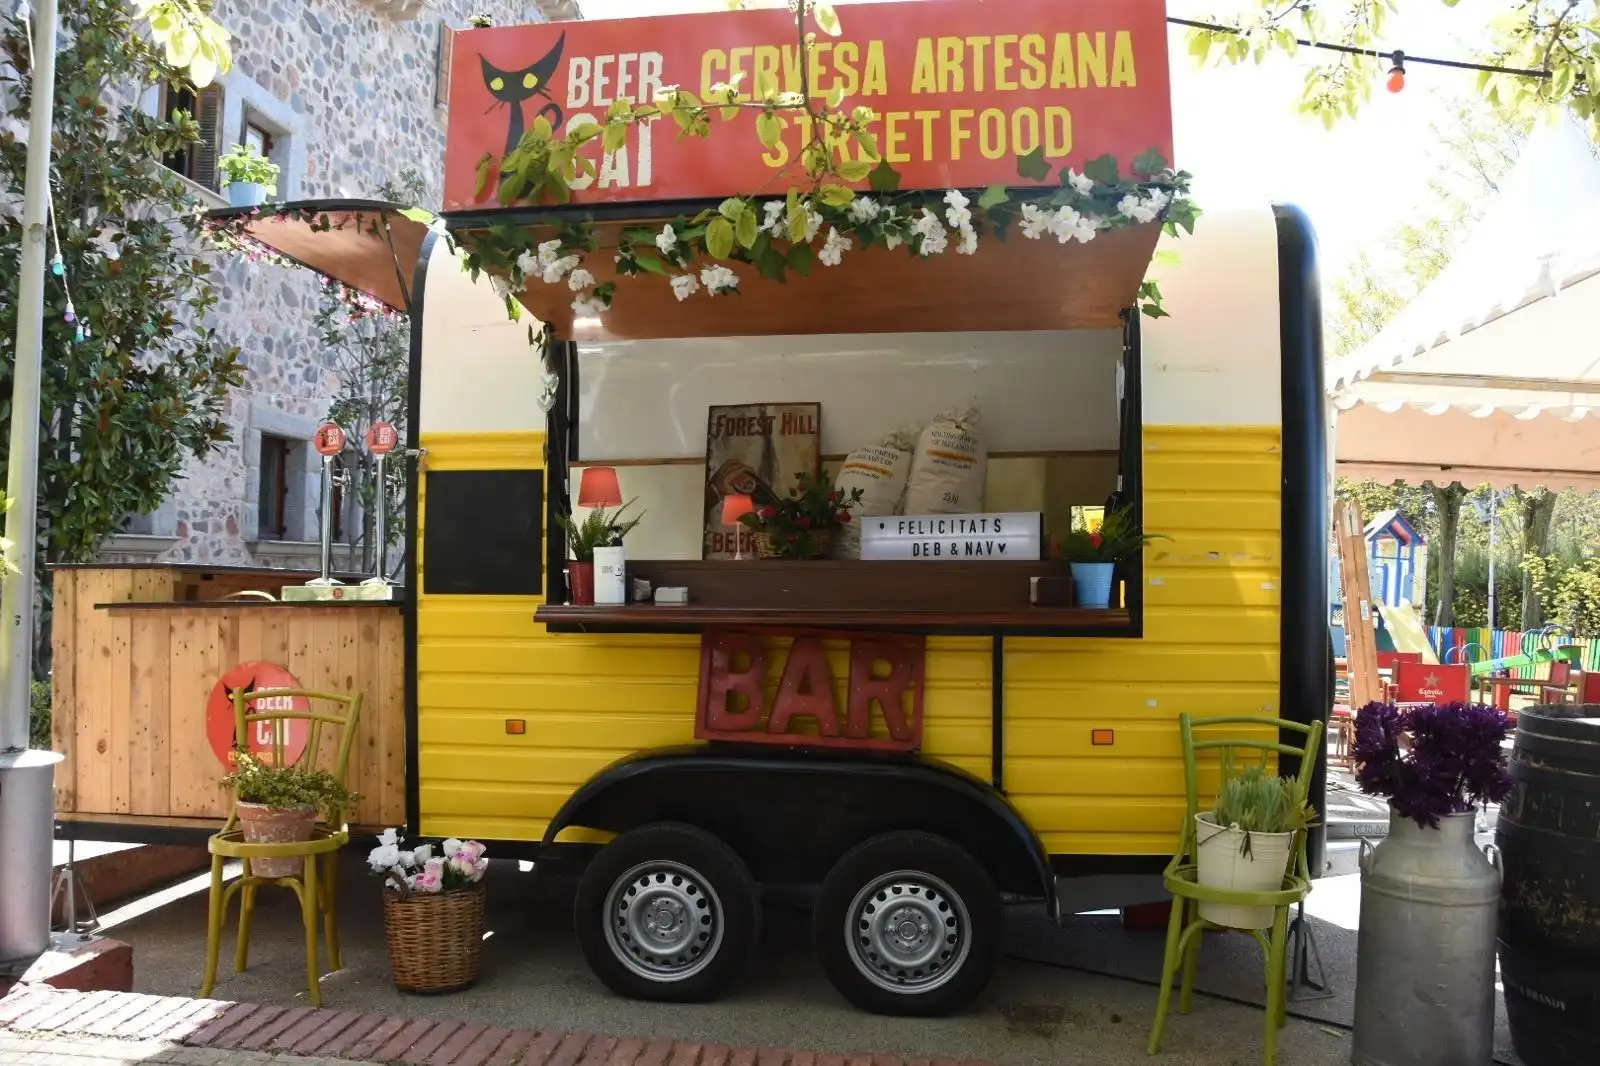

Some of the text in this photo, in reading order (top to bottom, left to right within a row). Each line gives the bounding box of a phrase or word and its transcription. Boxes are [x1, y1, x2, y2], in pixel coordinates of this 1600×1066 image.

[566, 51, 664, 109] BEER
[701, 31, 1137, 103] CERVESA ARTESANA
[950, 106, 1073, 161] FOOD
[780, 412, 818, 435] HILL
[898, 518, 1002, 535] FELICITATS
[912, 540, 994, 557] DEB & NAV
[706, 634, 914, 741] BAR
